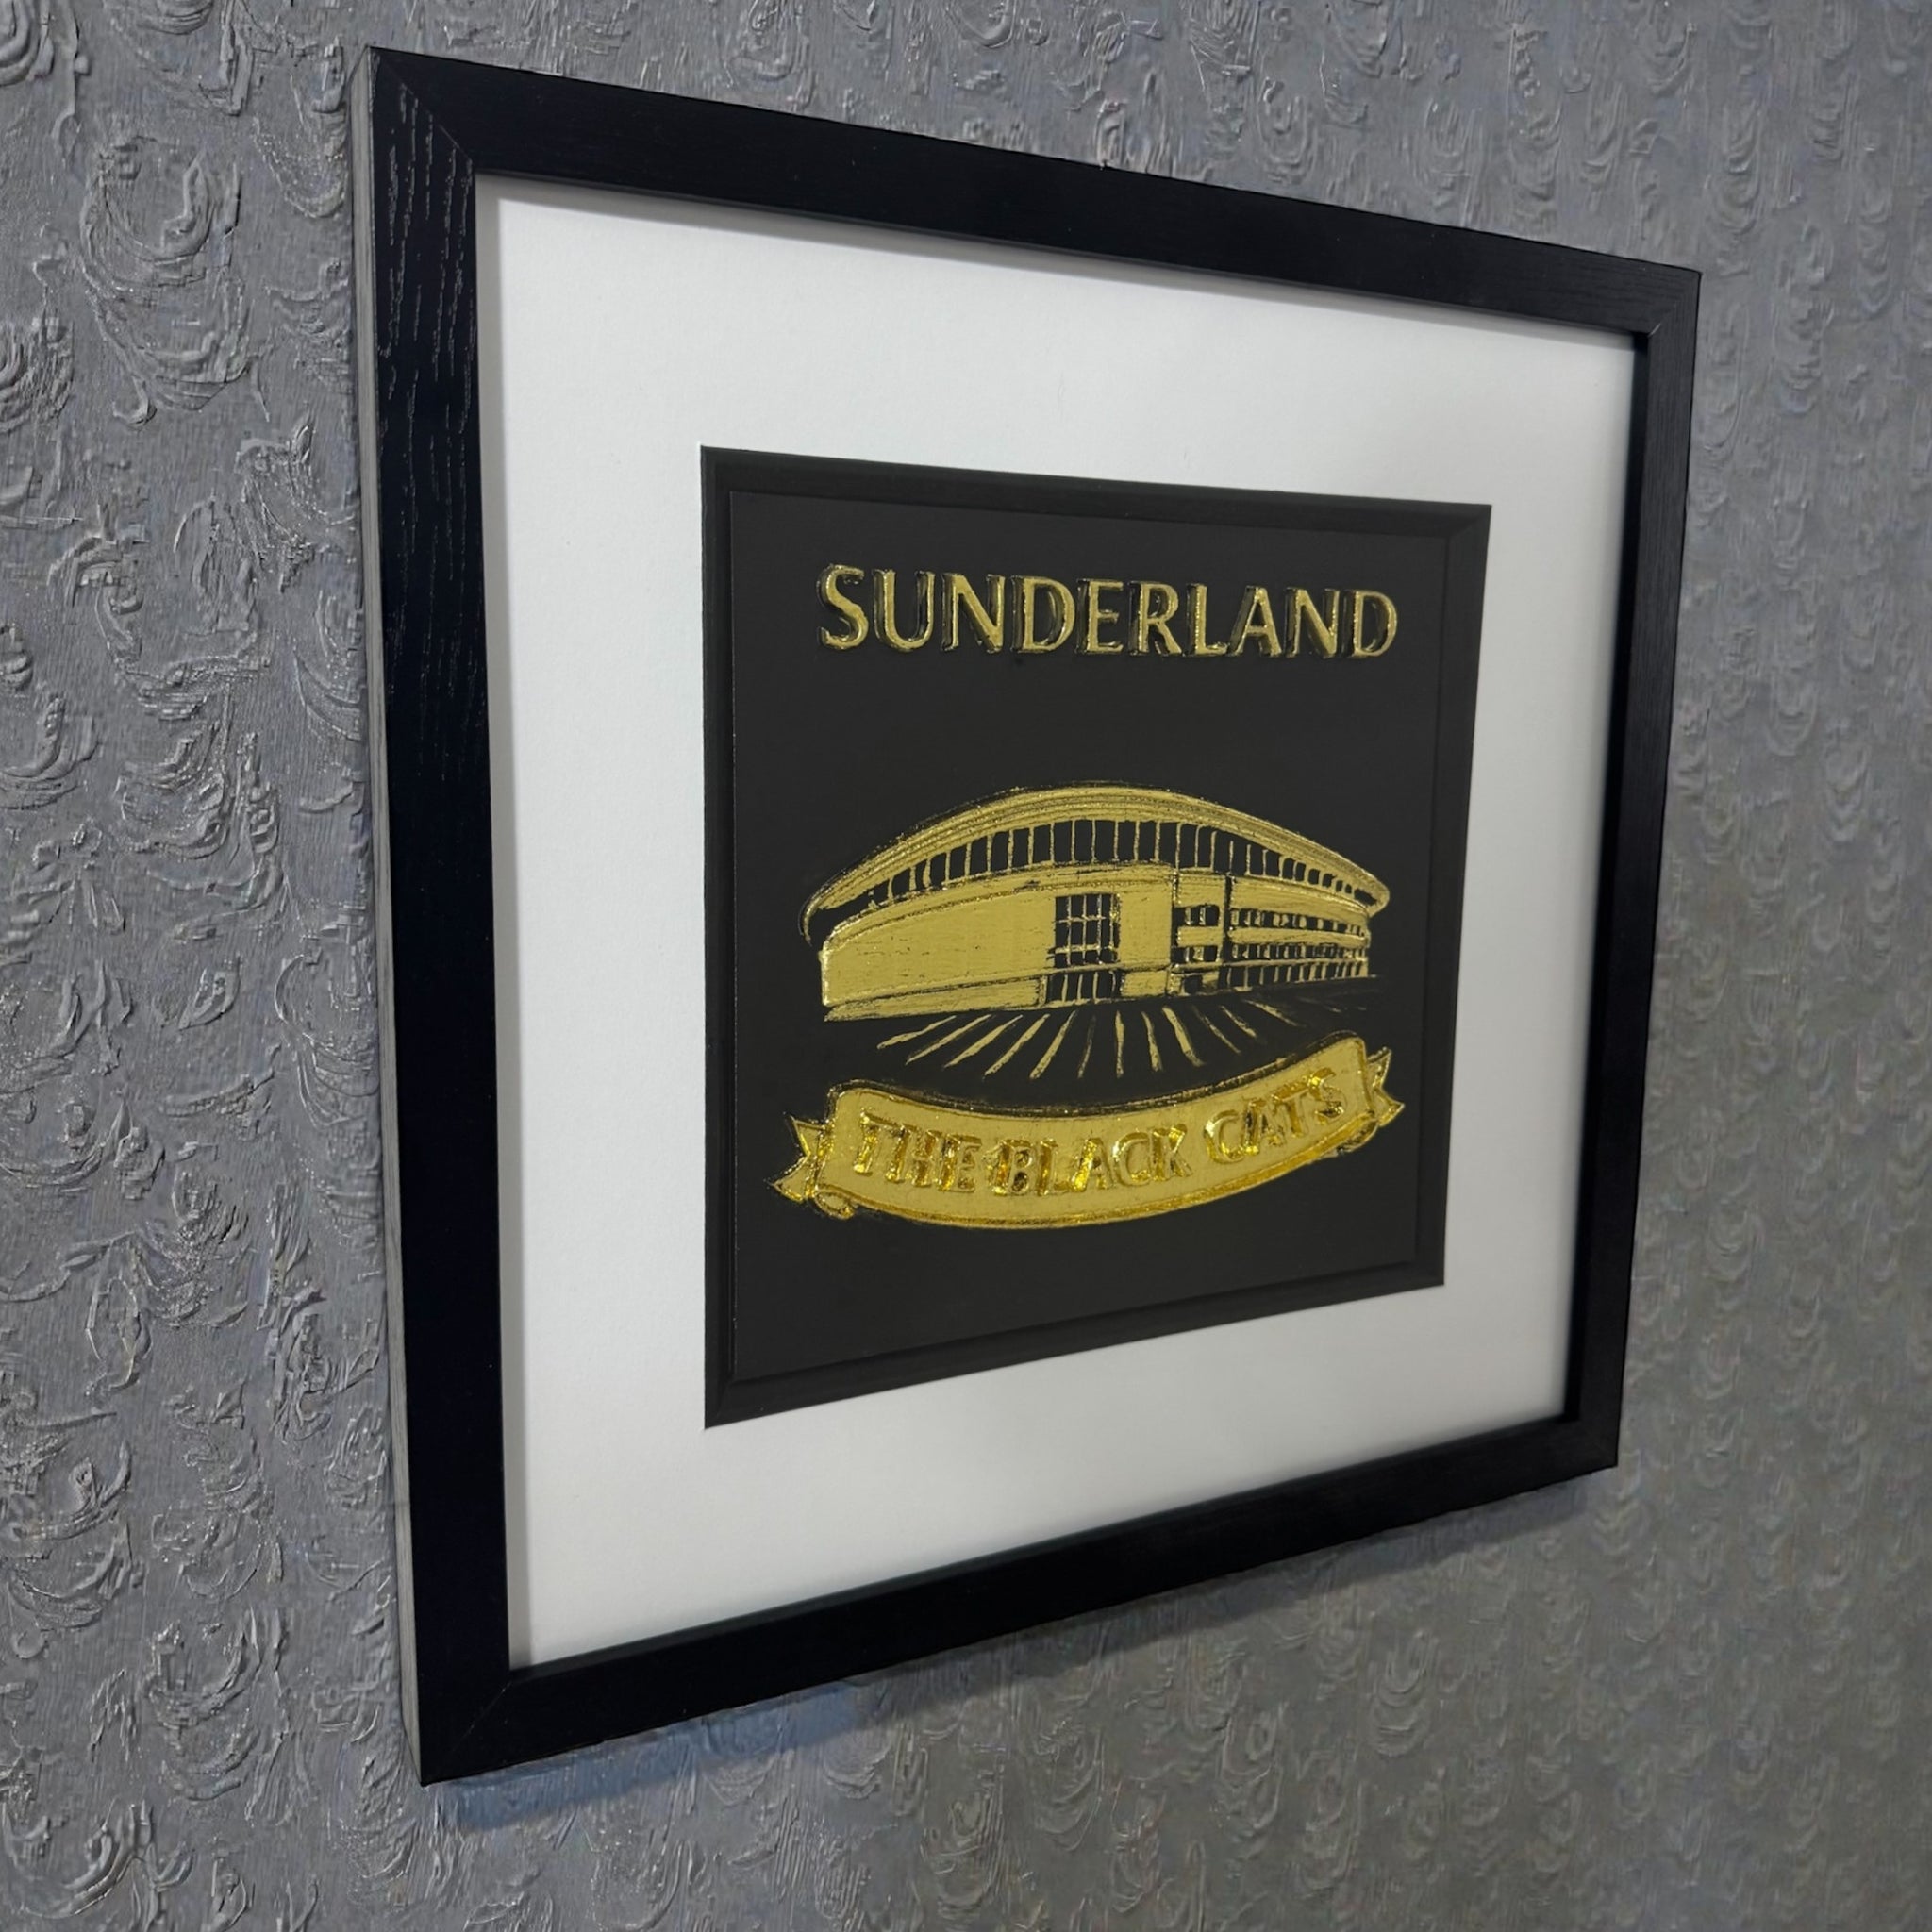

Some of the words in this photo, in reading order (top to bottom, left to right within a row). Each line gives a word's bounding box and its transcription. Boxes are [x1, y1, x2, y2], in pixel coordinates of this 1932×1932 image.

[818, 563, 1399, 658] SUNDERLAND
[852, 1112, 982, 1193] THE
[988, 1124, 1193, 1196] BLACK
[1203, 1067, 1347, 1165] CATS
